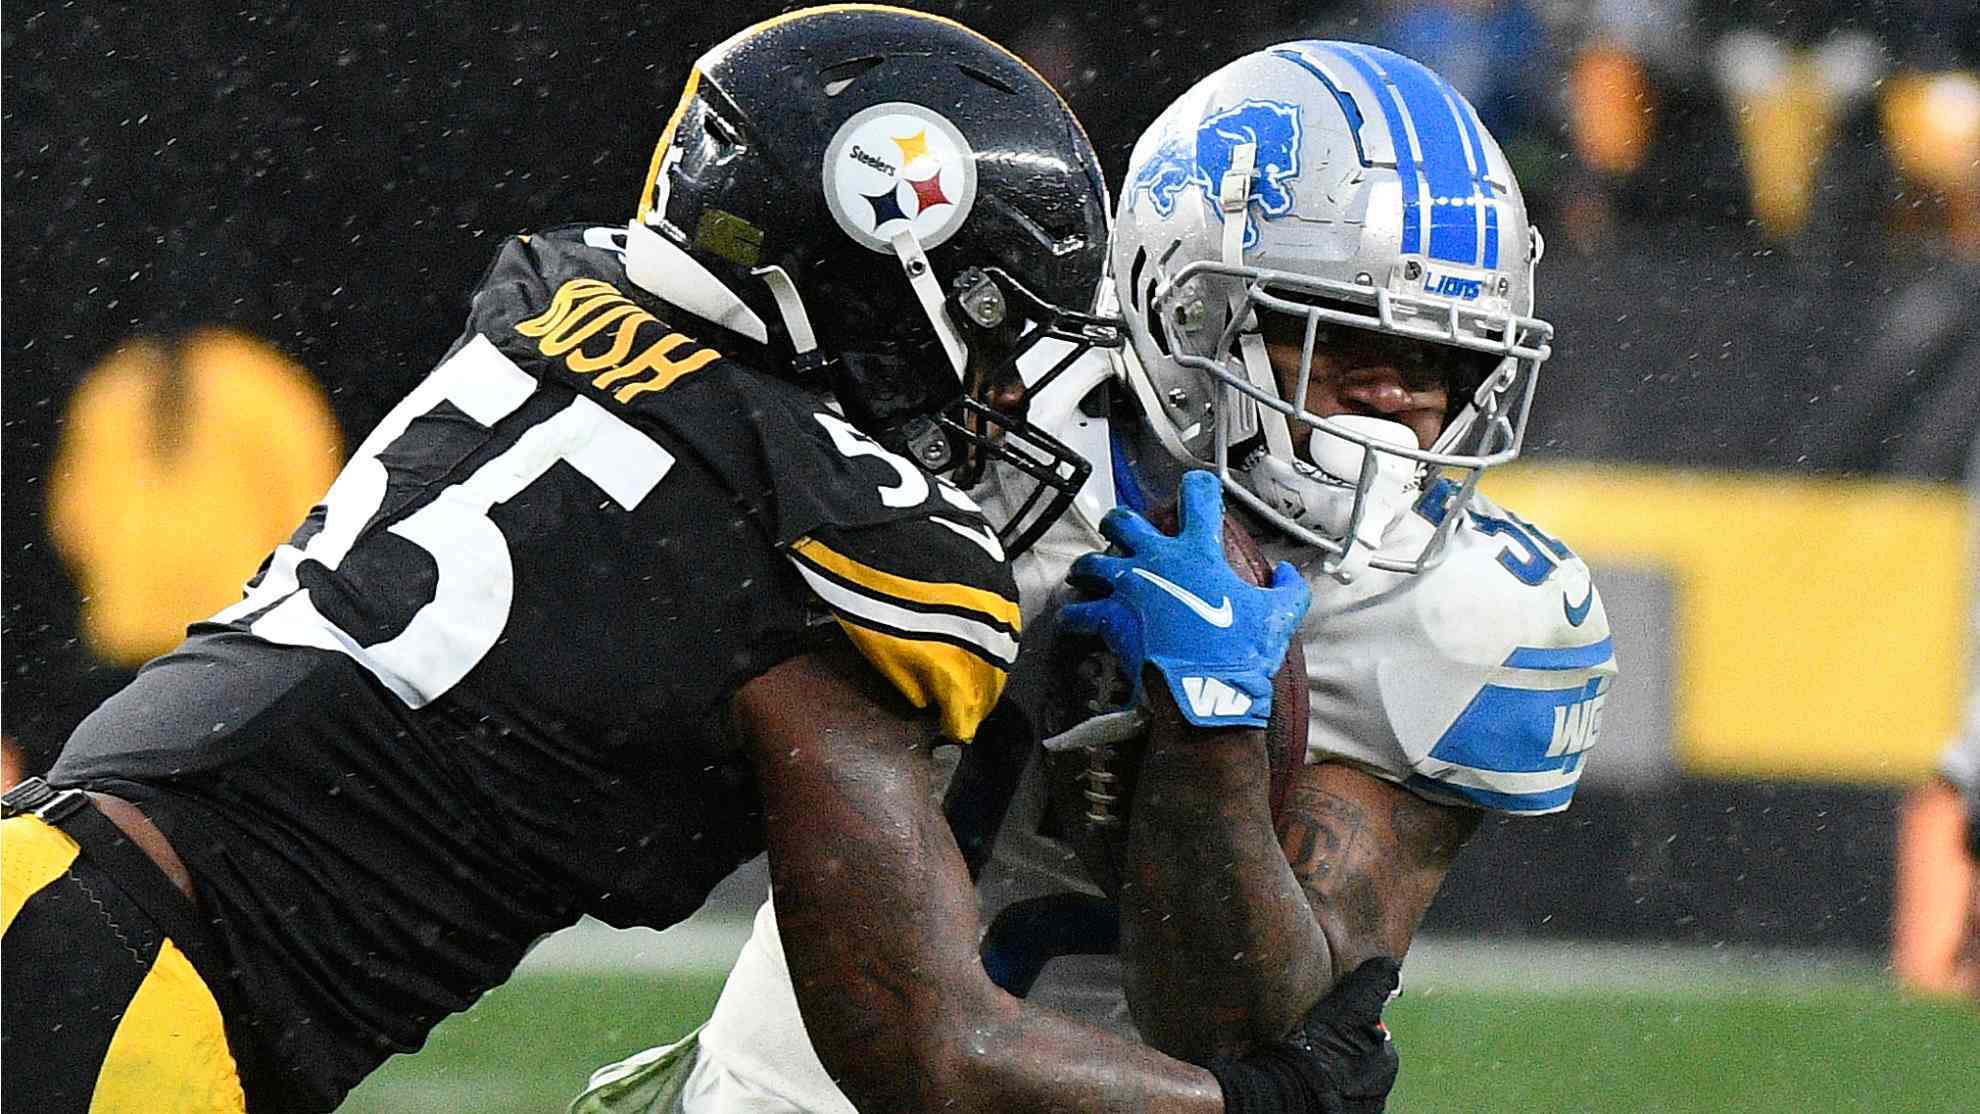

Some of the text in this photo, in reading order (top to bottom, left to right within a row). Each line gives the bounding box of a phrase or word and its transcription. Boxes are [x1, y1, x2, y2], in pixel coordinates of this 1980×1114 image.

[849, 145, 896, 177] Steelers
[515, 278, 722, 404] BUSH
[186, 333, 677, 710] 55
